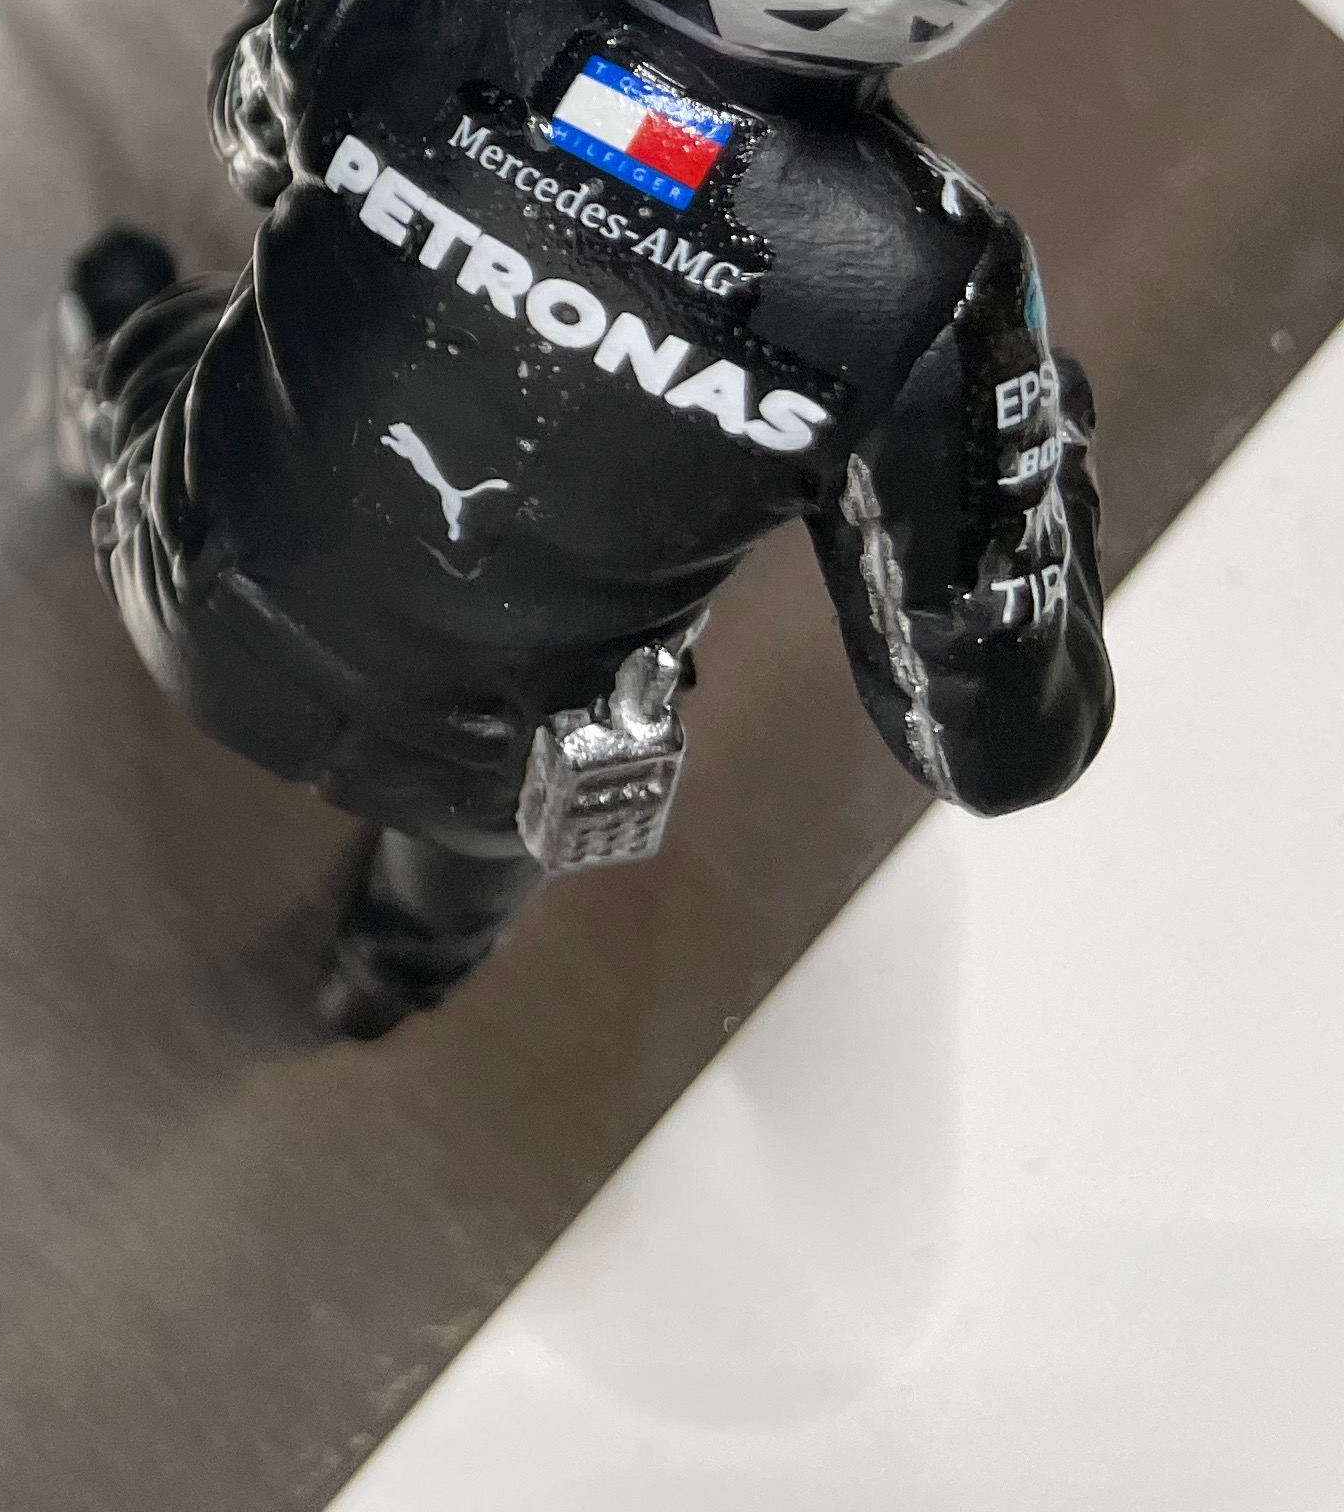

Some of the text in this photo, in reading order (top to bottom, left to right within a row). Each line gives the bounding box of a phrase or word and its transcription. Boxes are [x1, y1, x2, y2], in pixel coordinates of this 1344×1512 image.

[448, 115, 742, 296] Mercedes-AMG
[555, 127, 682, 200] HILFIGER
[324, 134, 829, 452] PETRONAS
